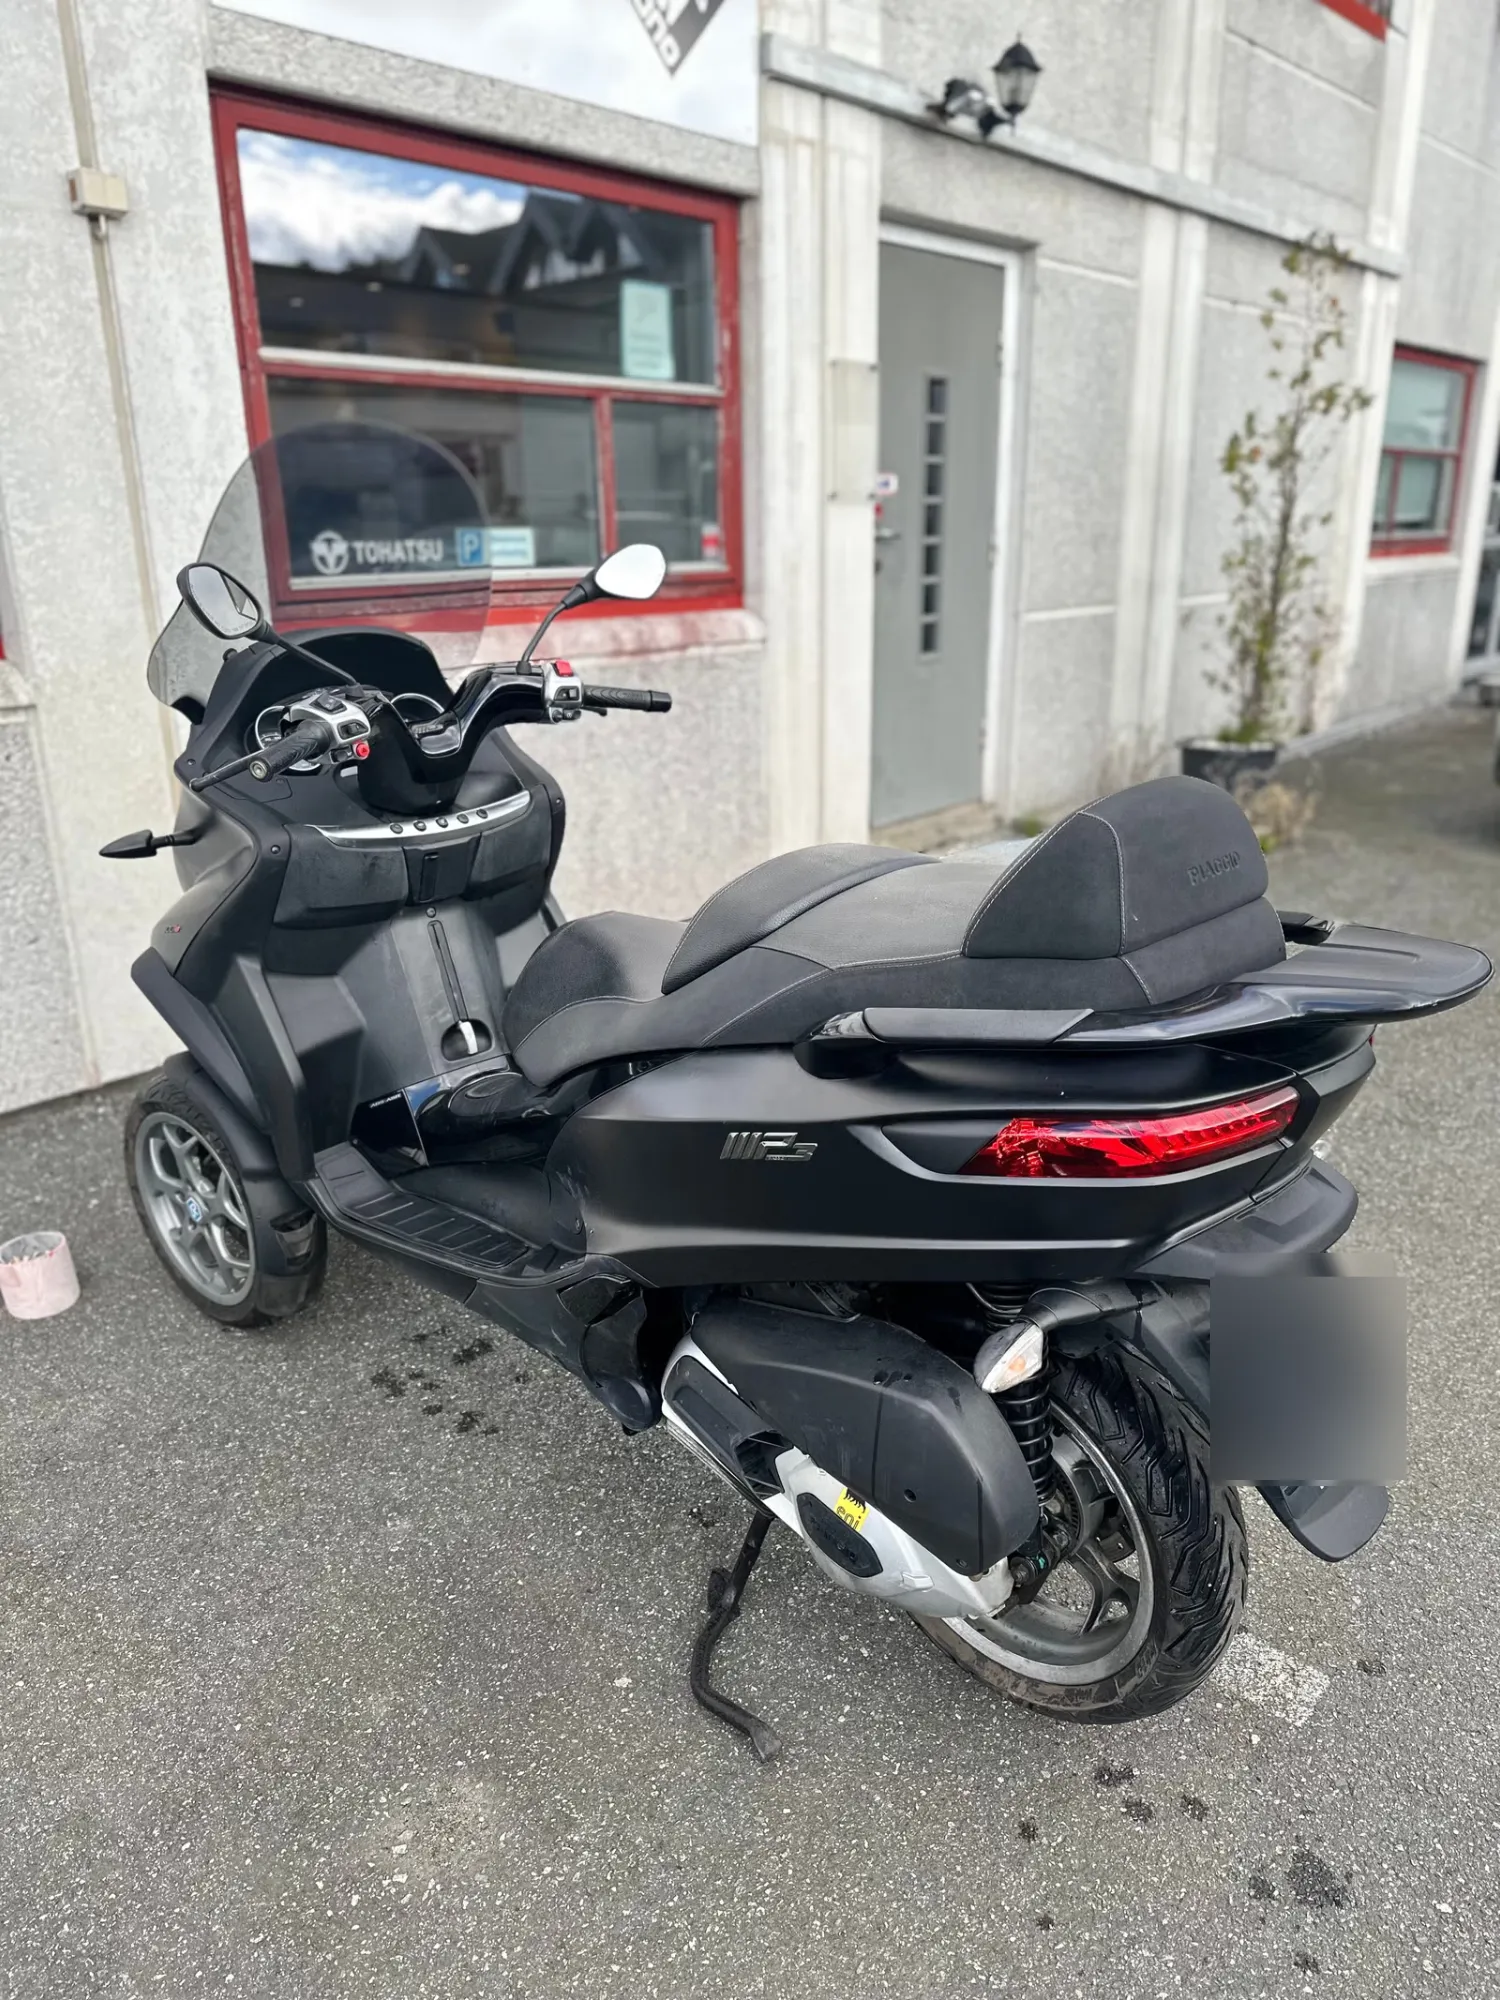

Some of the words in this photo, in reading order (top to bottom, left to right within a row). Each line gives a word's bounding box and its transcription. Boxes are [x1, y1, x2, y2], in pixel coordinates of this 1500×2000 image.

[353, 538, 444, 564] TOHATSU
[463, 532, 479, 562] P
[1186, 851, 1240, 886] PIAGGIO
[836, 1505, 862, 1530] eni
